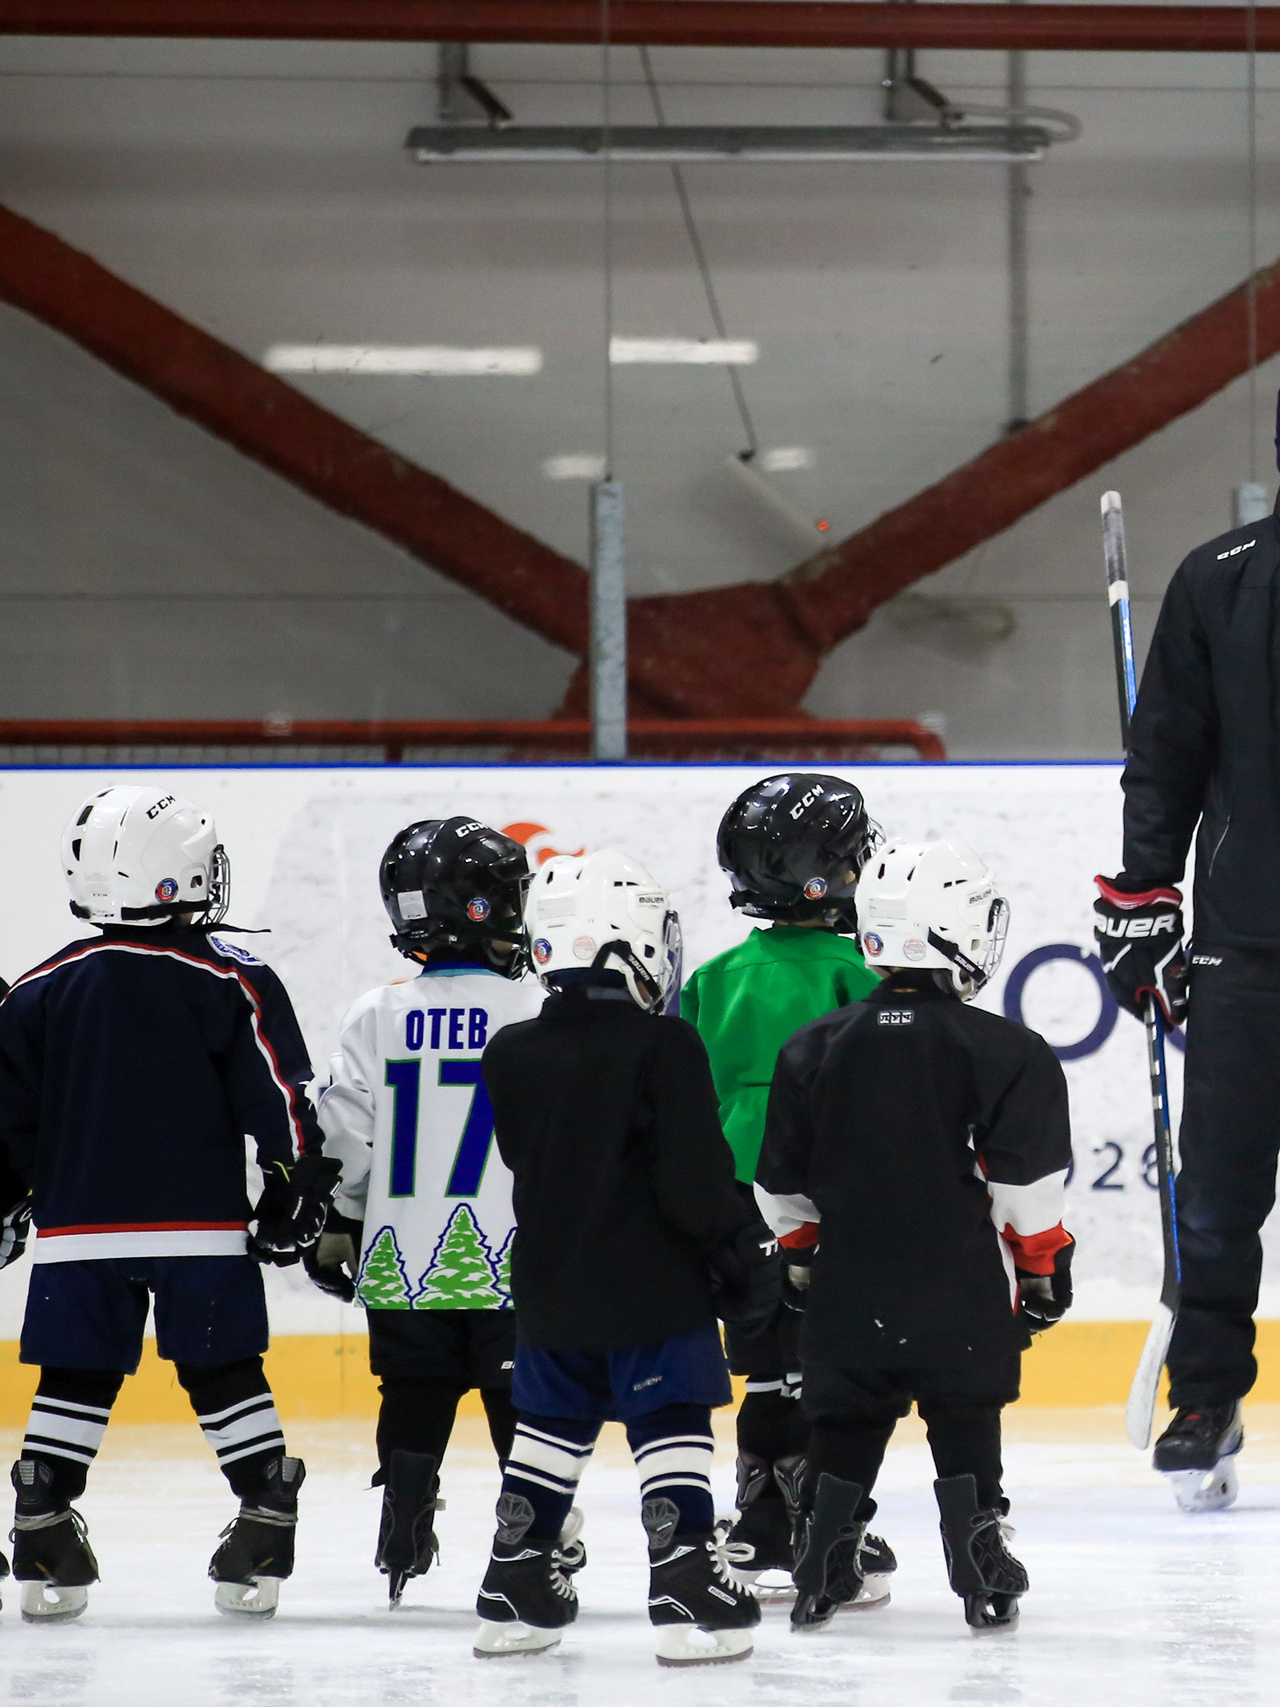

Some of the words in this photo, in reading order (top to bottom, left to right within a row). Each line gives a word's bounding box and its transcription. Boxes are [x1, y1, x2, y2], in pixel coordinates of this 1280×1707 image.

[146, 794, 176, 820] CCM
[789, 784, 825, 820] CCM
[1192, 955, 1223, 966] CCM
[384, 1057, 498, 1198] 17
